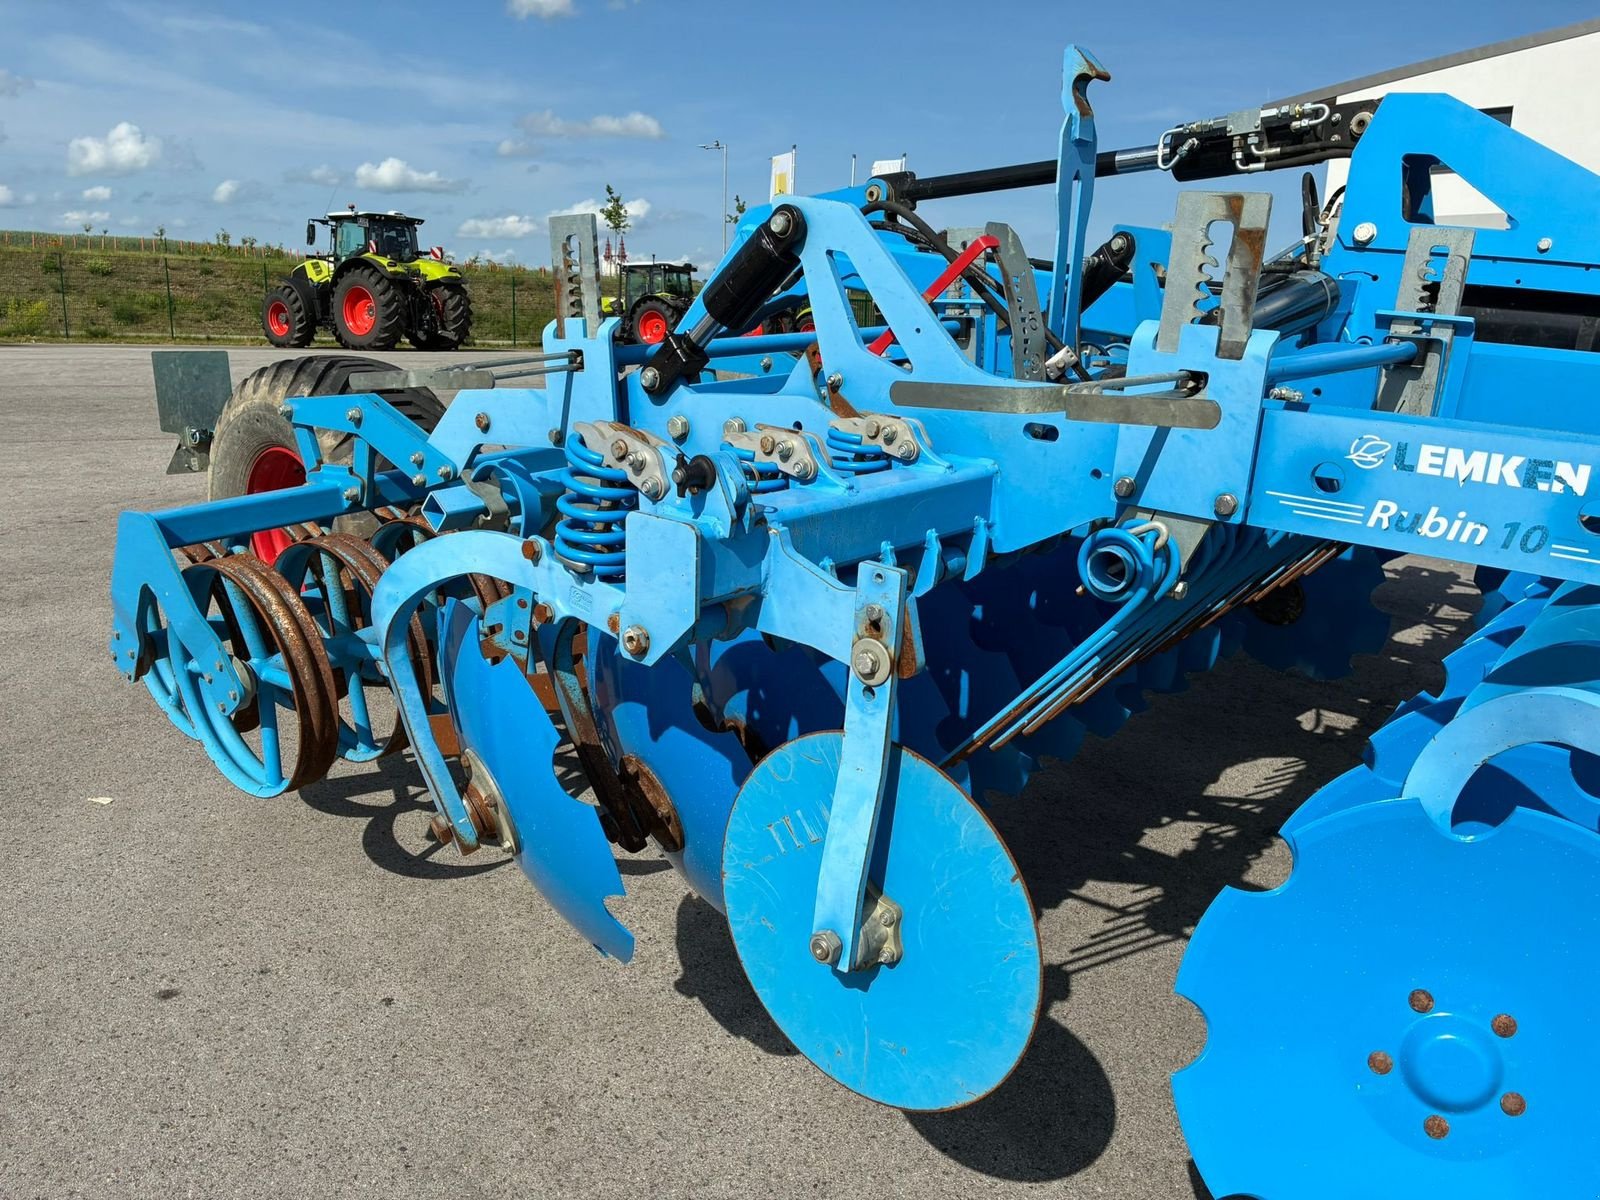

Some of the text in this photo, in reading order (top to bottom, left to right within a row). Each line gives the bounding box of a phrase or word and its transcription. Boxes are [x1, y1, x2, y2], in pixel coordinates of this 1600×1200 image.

[1393, 441, 1592, 497] LEMKEN
[1366, 499, 1550, 554] Rubin 10
